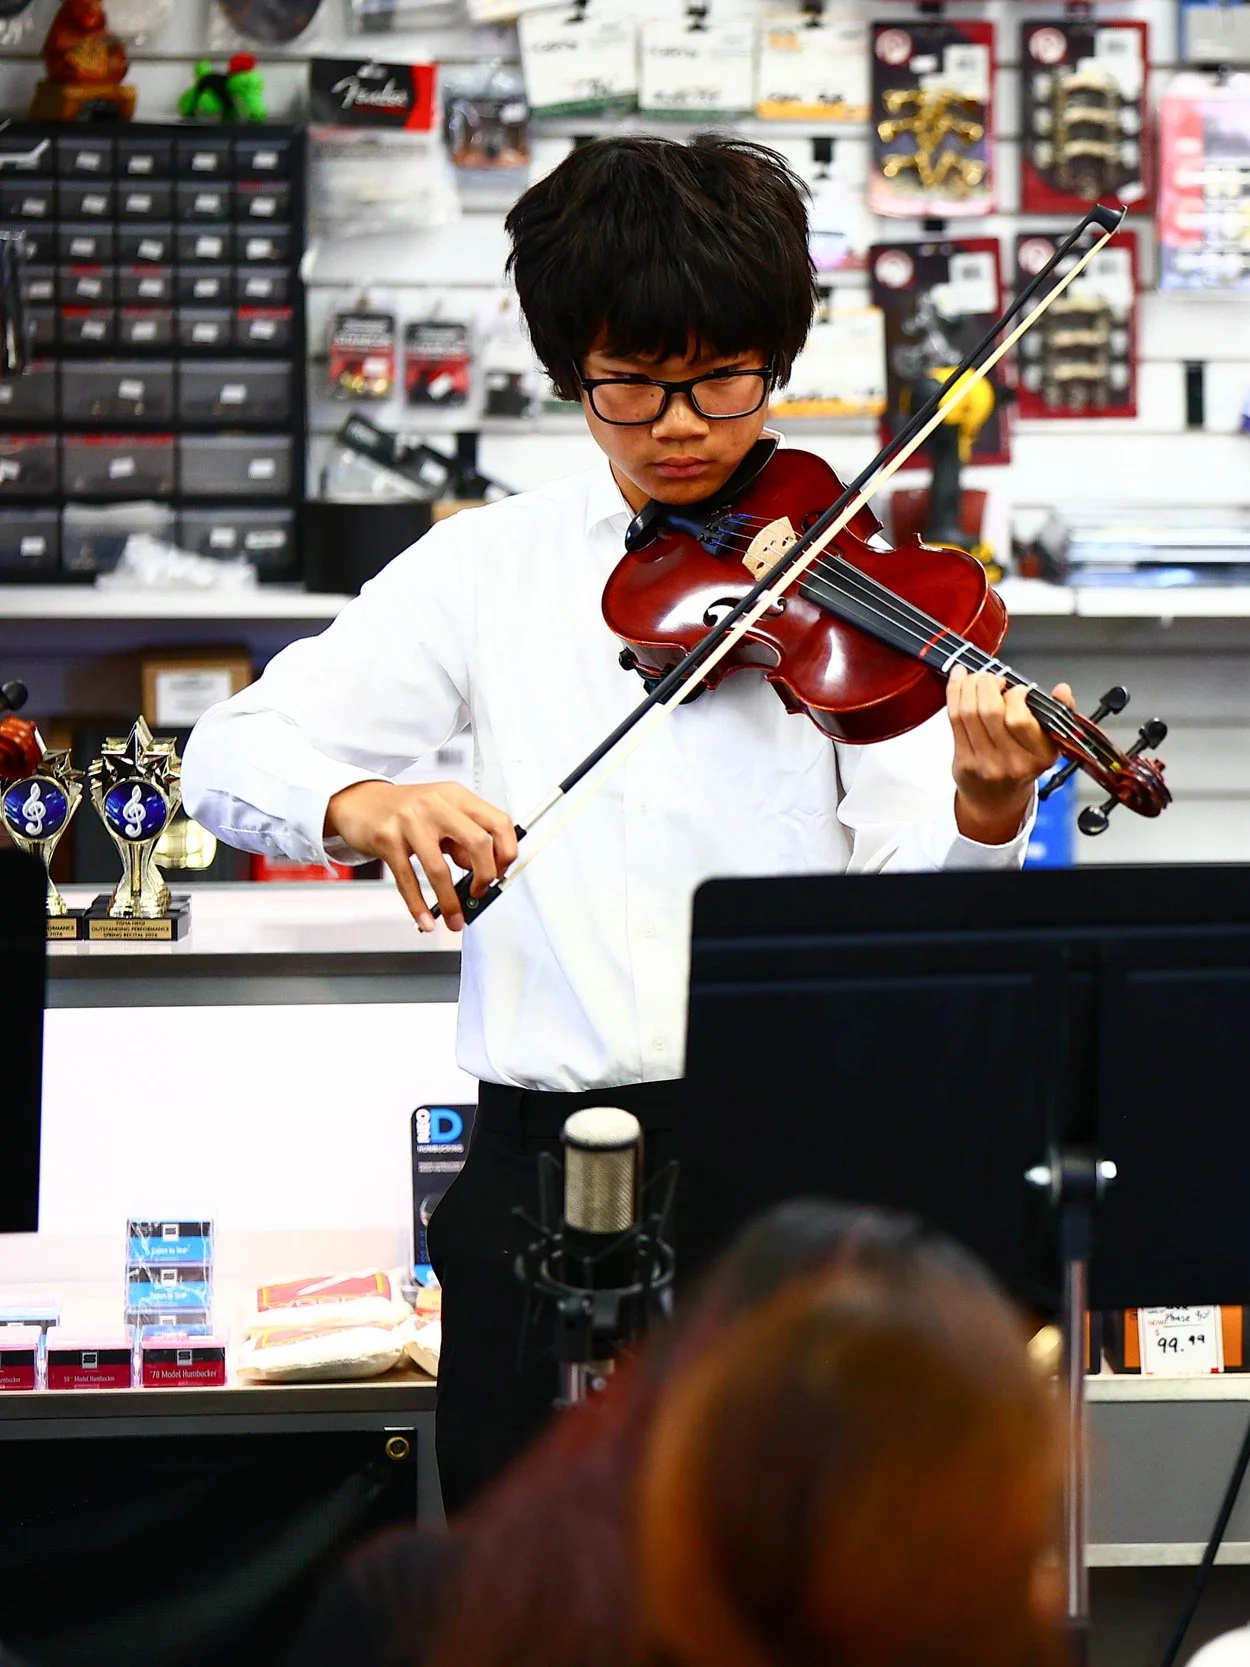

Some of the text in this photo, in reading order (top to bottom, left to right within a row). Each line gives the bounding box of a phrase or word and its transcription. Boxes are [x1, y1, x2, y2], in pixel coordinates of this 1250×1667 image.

[161, 1370, 182, 1378] Model
[182, 1368, 217, 1378] Humbucker
[90, 1375, 115, 1383] Humbucker
